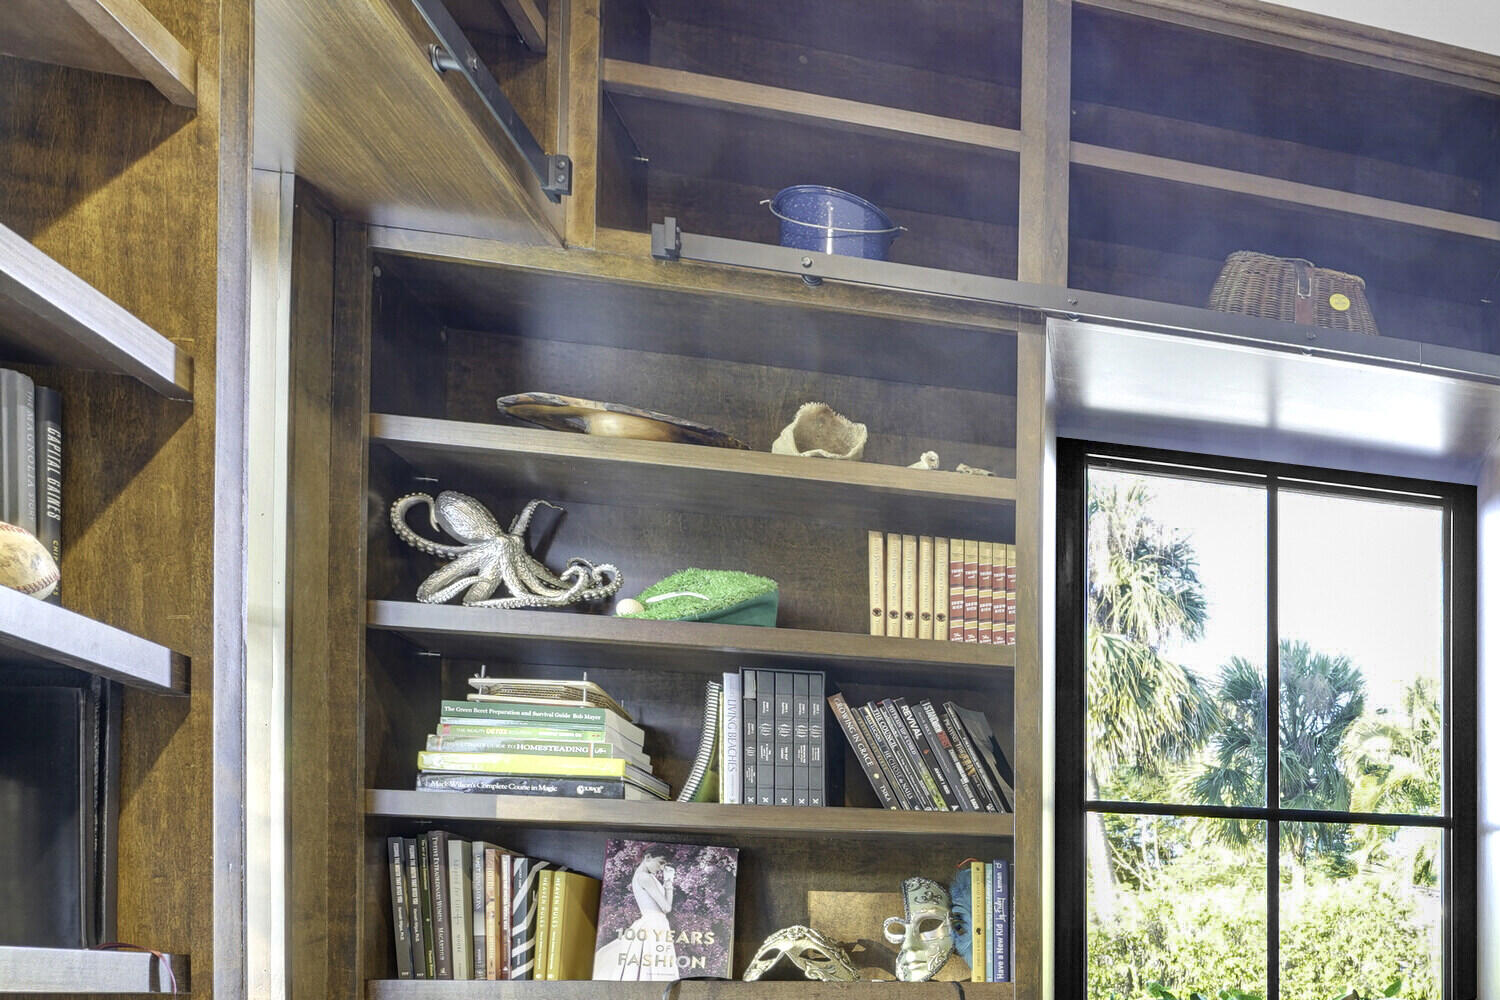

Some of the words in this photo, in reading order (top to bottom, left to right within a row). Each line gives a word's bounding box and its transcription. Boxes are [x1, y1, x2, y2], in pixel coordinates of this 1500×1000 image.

[26, 409, 34, 489] MAGNOLIA
[47, 427, 61, 475] CAPITAL
[47, 476, 61, 521] GAINES
[489, 708, 520, 717] Preparation
[533, 710, 553, 718] Survival
[727, 699, 736, 729] LIVING
[871, 708, 882, 722] THE
[878, 720, 898, 748] COUNCIL
[899, 703, 923, 739] REVIVAL
[832, 695, 857, 733] GROWING
[852, 732, 862, 742] IN
[857, 741, 874, 766] GRACE
[516, 744, 589, 753] HOMESTEADING
[726, 731, 736, 772] BEACHES
[450, 780, 476, 789] Wilson's
[477, 781, 505, 791] Complete
[506, 783, 530, 791] Course
[538, 784, 557, 792] Magic
[432, 857, 442, 900] EXTRAORDINARY
[553, 877, 561, 904] HEAVEN
[435, 900, 443, 921] WOMEN
[616, 928, 647, 941] 100
[653, 929, 715, 945] YEARS
[656, 944, 672, 952] OF
[618, 953, 706, 969] FASHION
